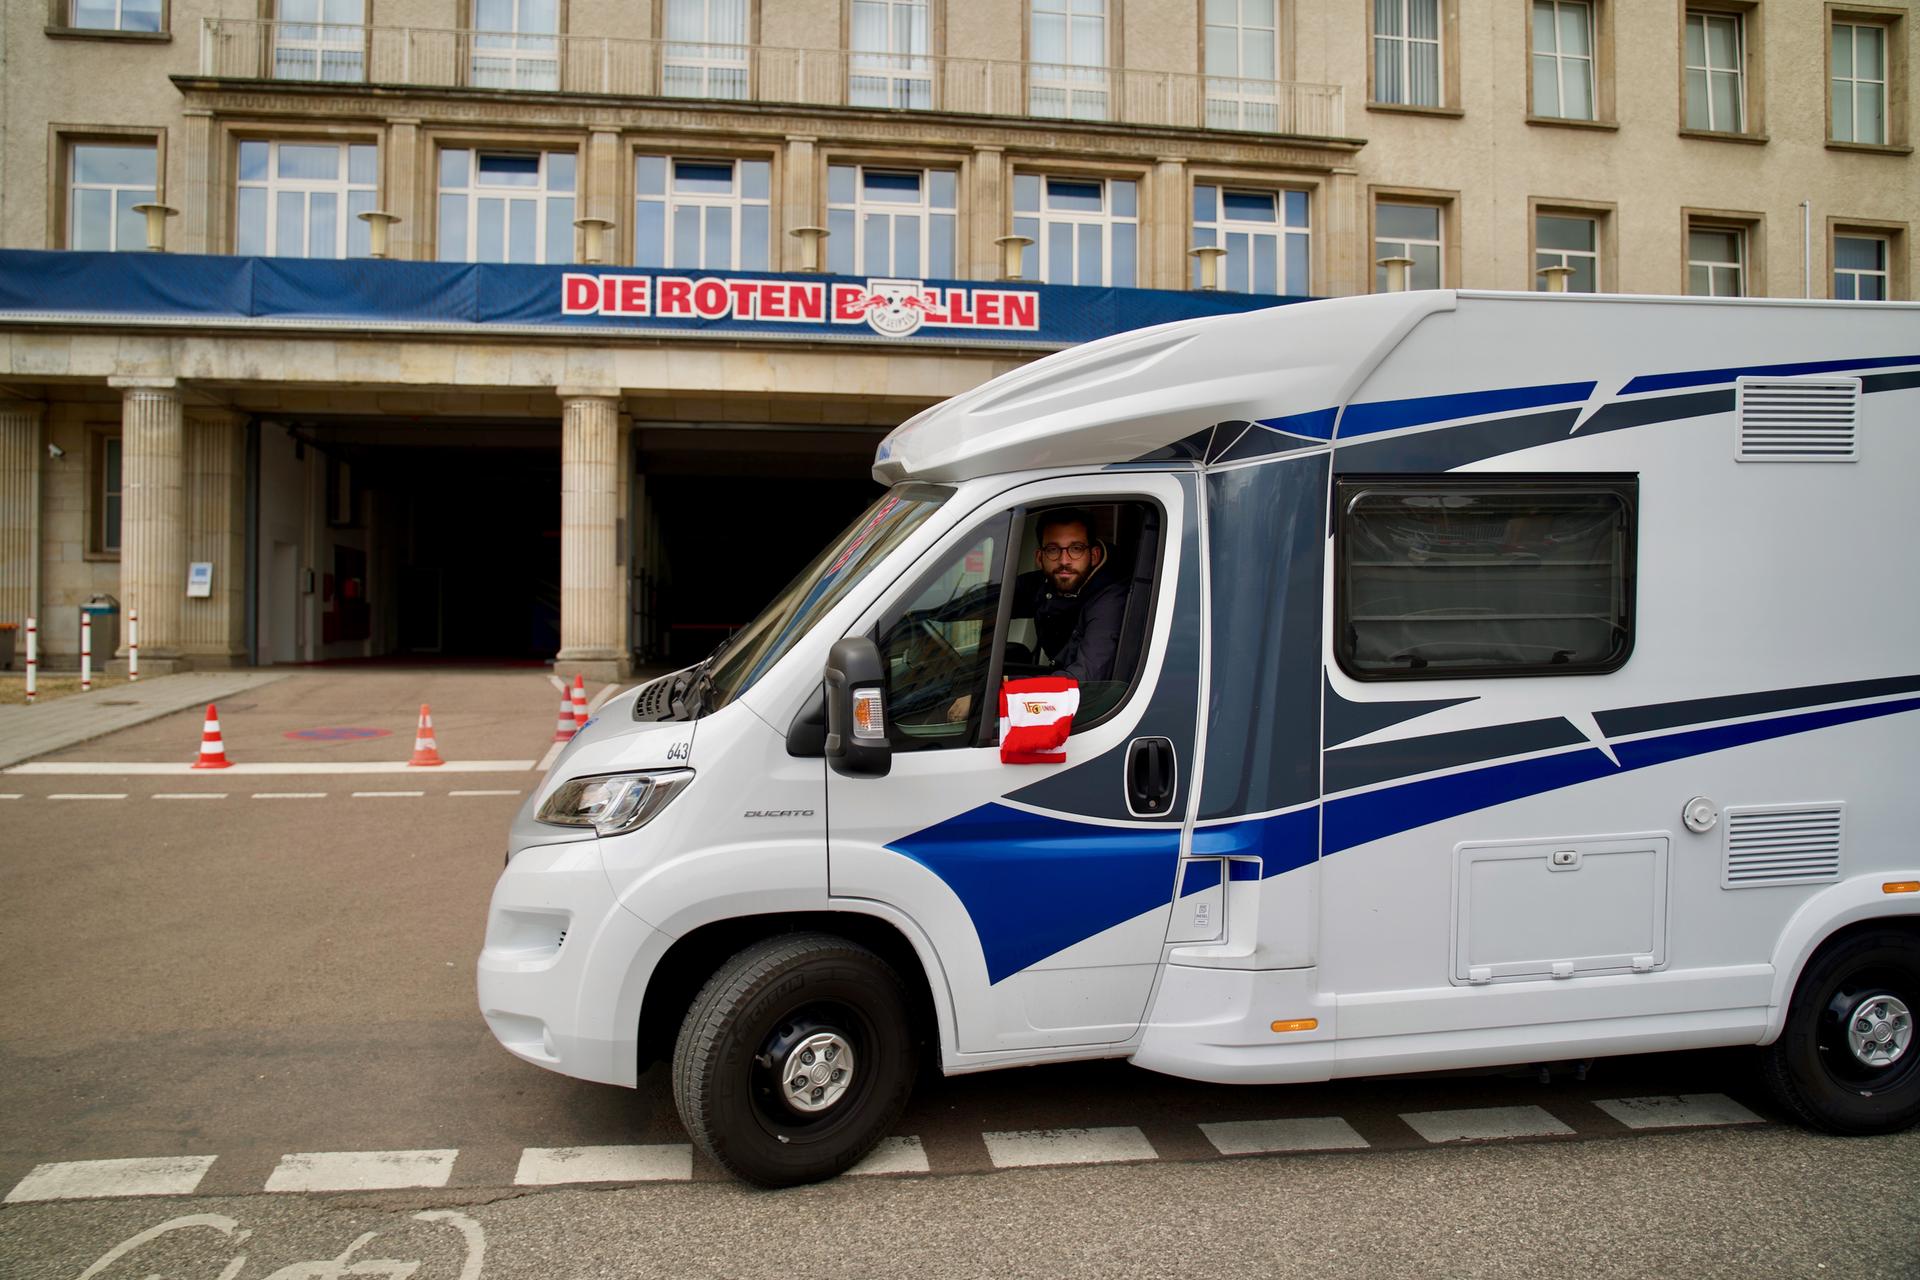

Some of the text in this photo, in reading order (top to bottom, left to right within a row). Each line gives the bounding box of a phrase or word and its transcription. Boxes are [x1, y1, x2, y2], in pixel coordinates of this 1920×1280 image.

[563, 274, 1039, 331] DIE ROTEN BLLEN
[667, 742, 689, 760] 643
[743, 809, 815, 818] DUCATO
